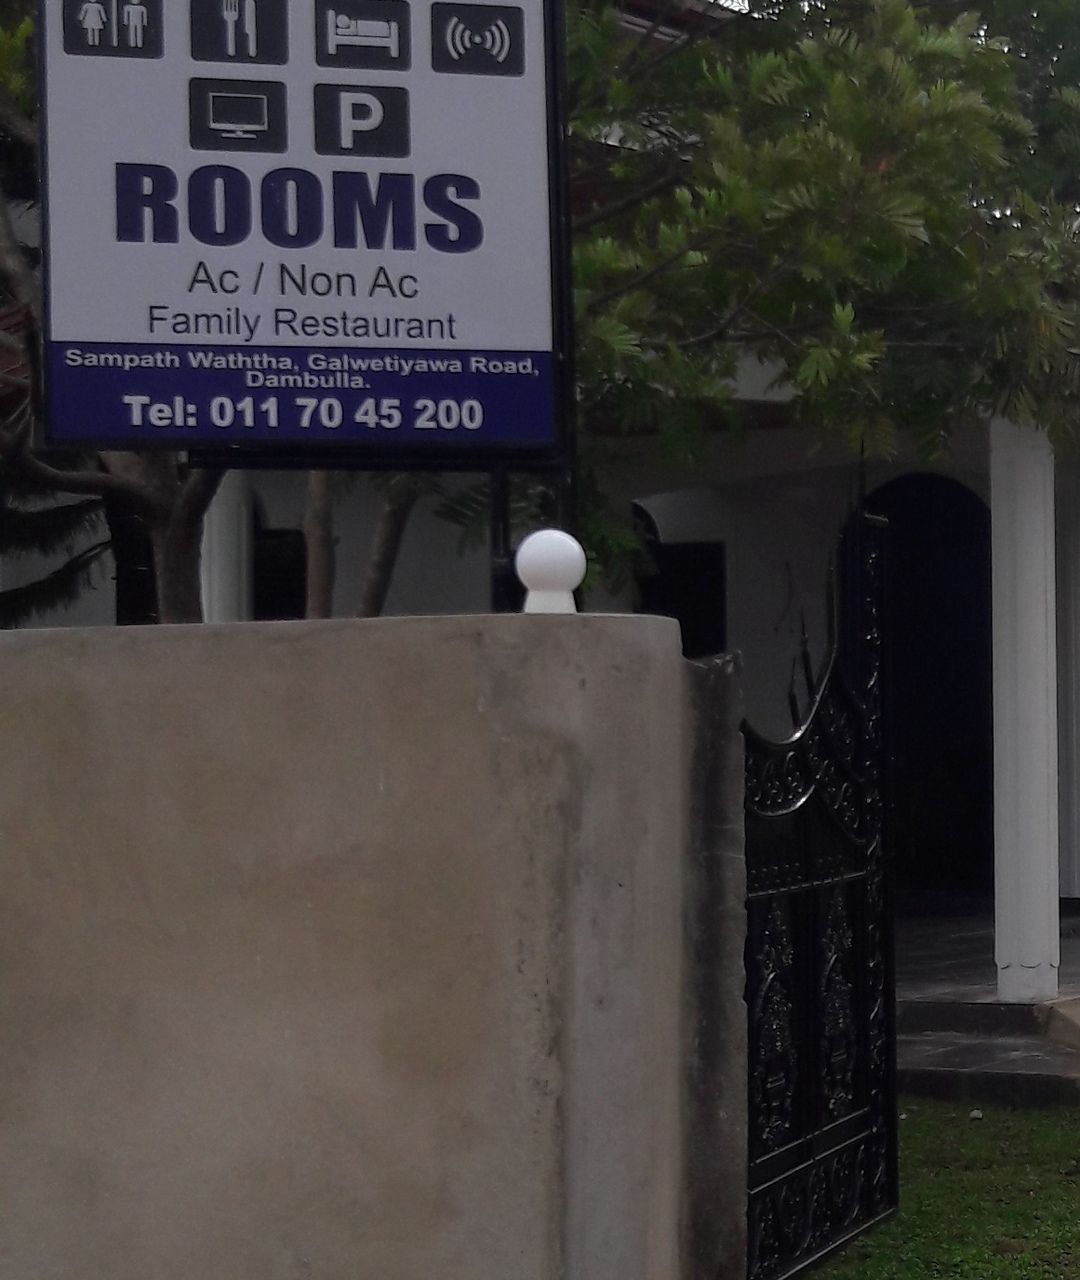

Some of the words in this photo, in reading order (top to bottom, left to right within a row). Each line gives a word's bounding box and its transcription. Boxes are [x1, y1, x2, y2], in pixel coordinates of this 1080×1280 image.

[339, 92, 384, 148] P
[115, 163, 484, 253] ROOMS
[188, 261, 240, 295] Ac
[253, 262, 264, 295] /
[280, 264, 356, 296] Non
[369, 266, 419, 298] Ac
[148, 305, 261, 342] Family
[274, 308, 456, 340] Restaurant
[65, 349, 180, 370] Sampath
[307, 354, 463, 376] Galwetiyawa
[470, 356, 540, 376] Road,
[246, 370, 371, 389] Dambulla.
[123, 395, 197, 427] Tel:
[210, 396, 278, 427] 011
[296, 397, 343, 428] 70
[354, 398, 402, 429] 45
[414, 398, 483, 430] 200
